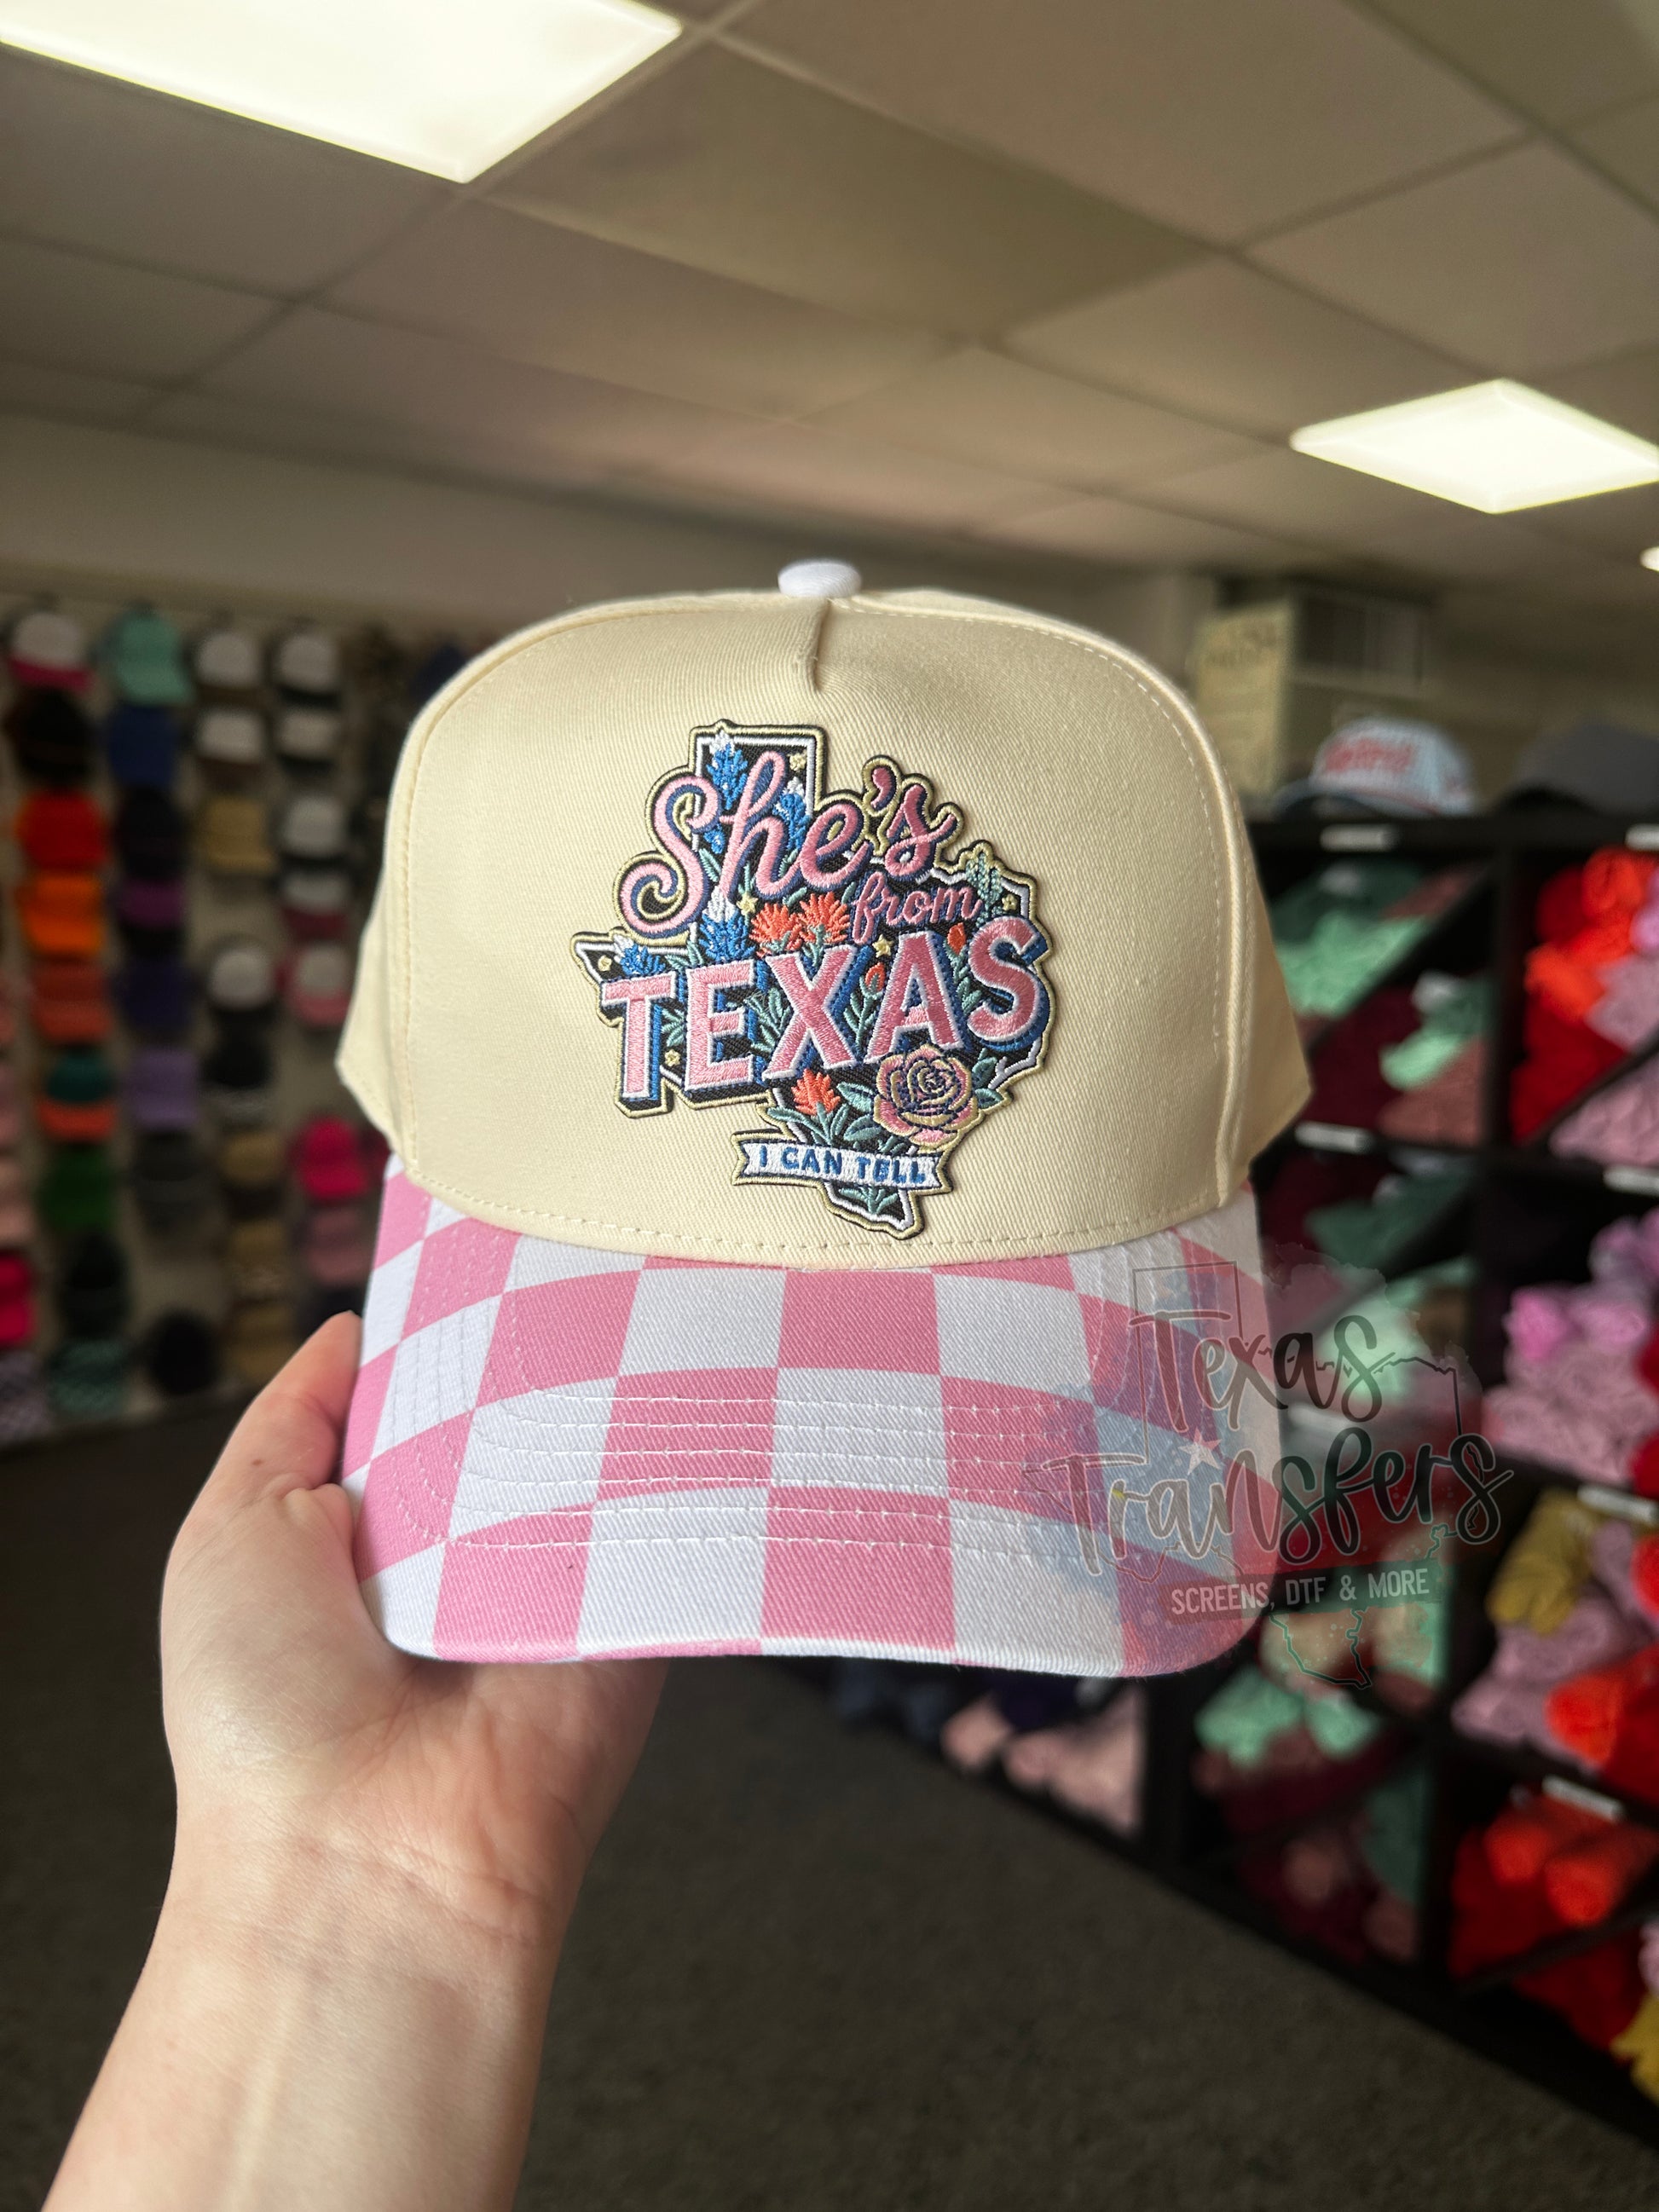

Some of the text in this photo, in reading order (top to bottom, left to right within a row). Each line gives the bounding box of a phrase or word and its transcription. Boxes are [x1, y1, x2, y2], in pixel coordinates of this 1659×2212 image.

[618, 750, 957, 938] She's
[851, 871, 983, 943] from
[599, 914, 1042, 1100] TEXAS
[759, 1145, 927, 1183] I CAN TELL
